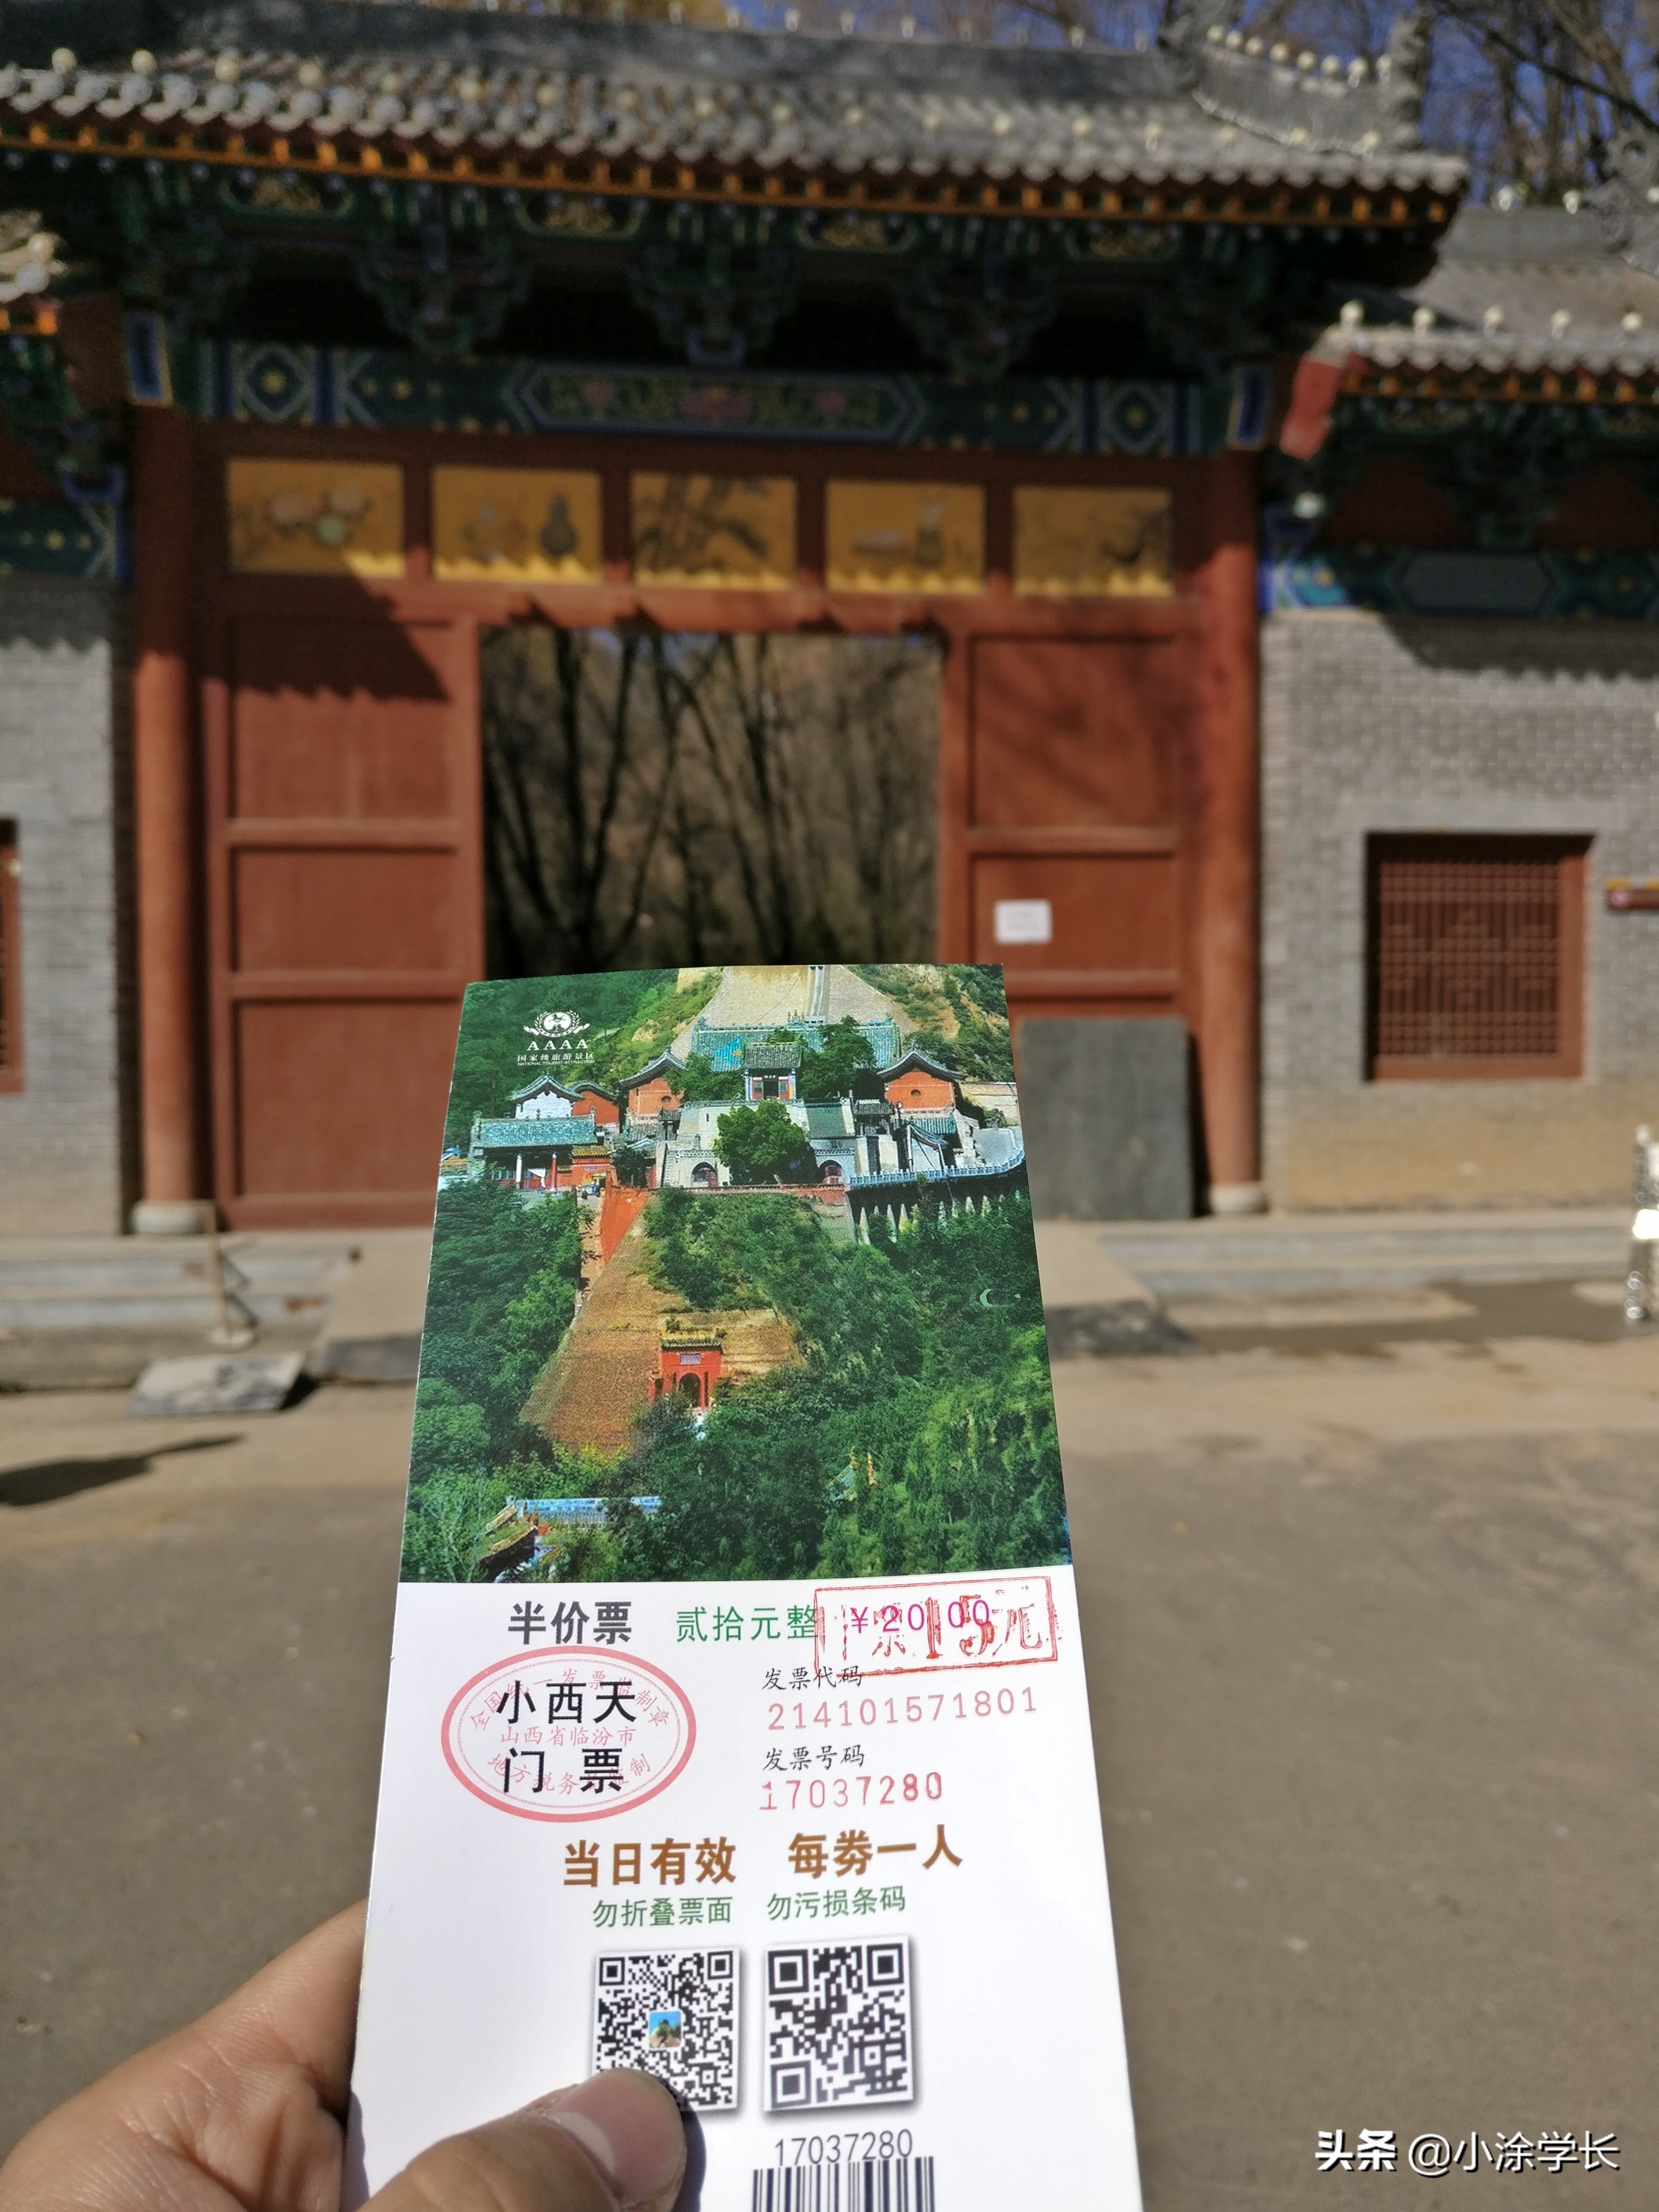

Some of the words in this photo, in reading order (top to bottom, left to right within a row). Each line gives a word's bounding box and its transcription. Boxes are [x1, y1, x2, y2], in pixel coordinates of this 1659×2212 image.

[508, 1600, 632, 1645] 半价票
[676, 1604, 819, 1642] 贰拾元整
[762, 1666, 863, 1691] 发票代码
[497, 1680, 637, 1724] 小西天
[768, 1687, 1036, 1731] 214101571801
[501, 1725, 636, 1748] 山西省临汾市
[763, 1745, 865, 1771] 发票号码
[759, 1772, 942, 1811] 17037280
[563, 1835, 737, 1888] 当日有效
[592, 1895, 733, 1927] 勿折叠票面
[767, 1885, 906, 1921] 勿污损条码
[774, 2128, 913, 2167] 17037280
